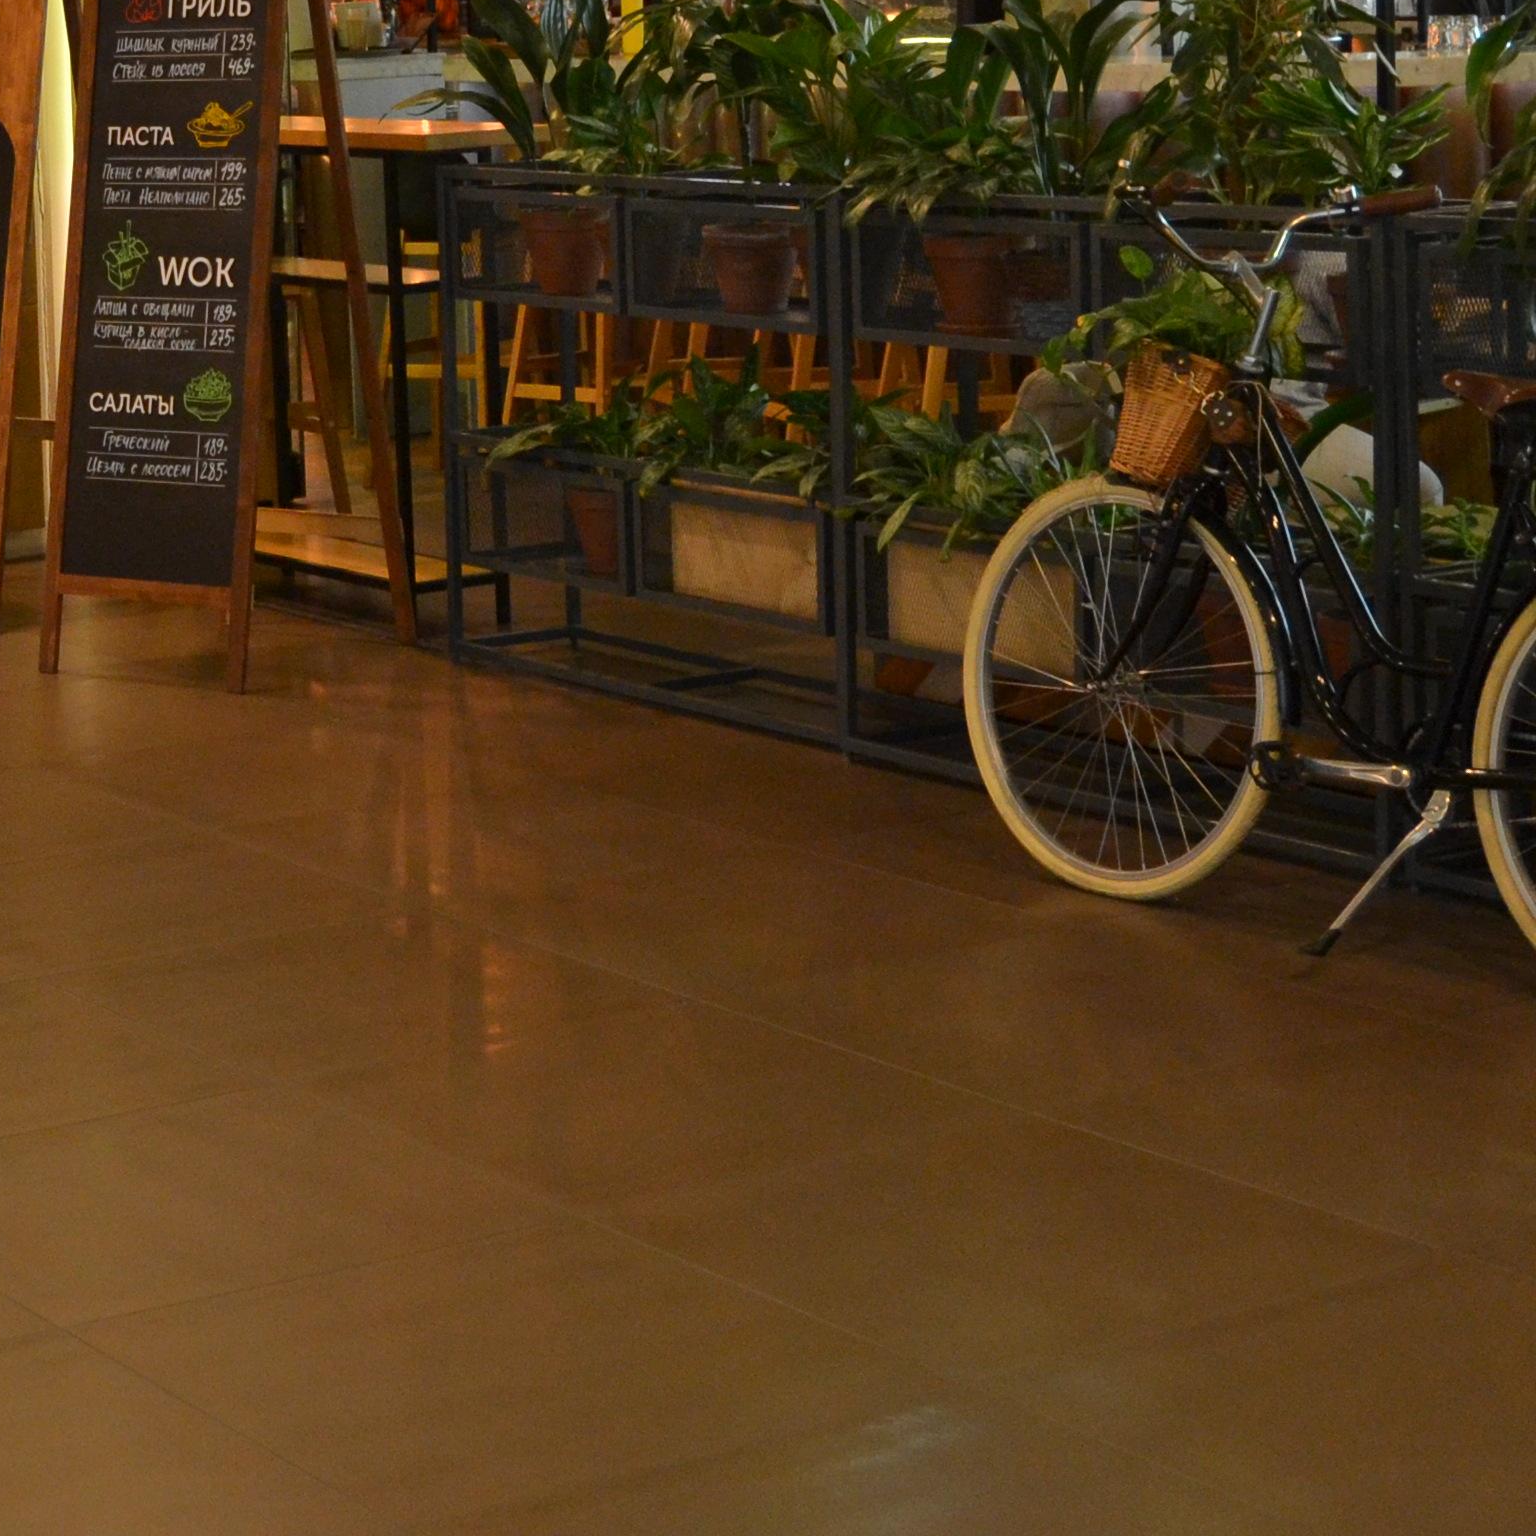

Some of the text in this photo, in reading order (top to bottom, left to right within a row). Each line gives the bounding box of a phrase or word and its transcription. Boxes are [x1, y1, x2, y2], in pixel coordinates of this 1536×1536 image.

[107, 126, 174, 146] ПАСТА
[158, 255, 235, 288] WOK
[89, 392, 174, 415] САЛАТЫ
